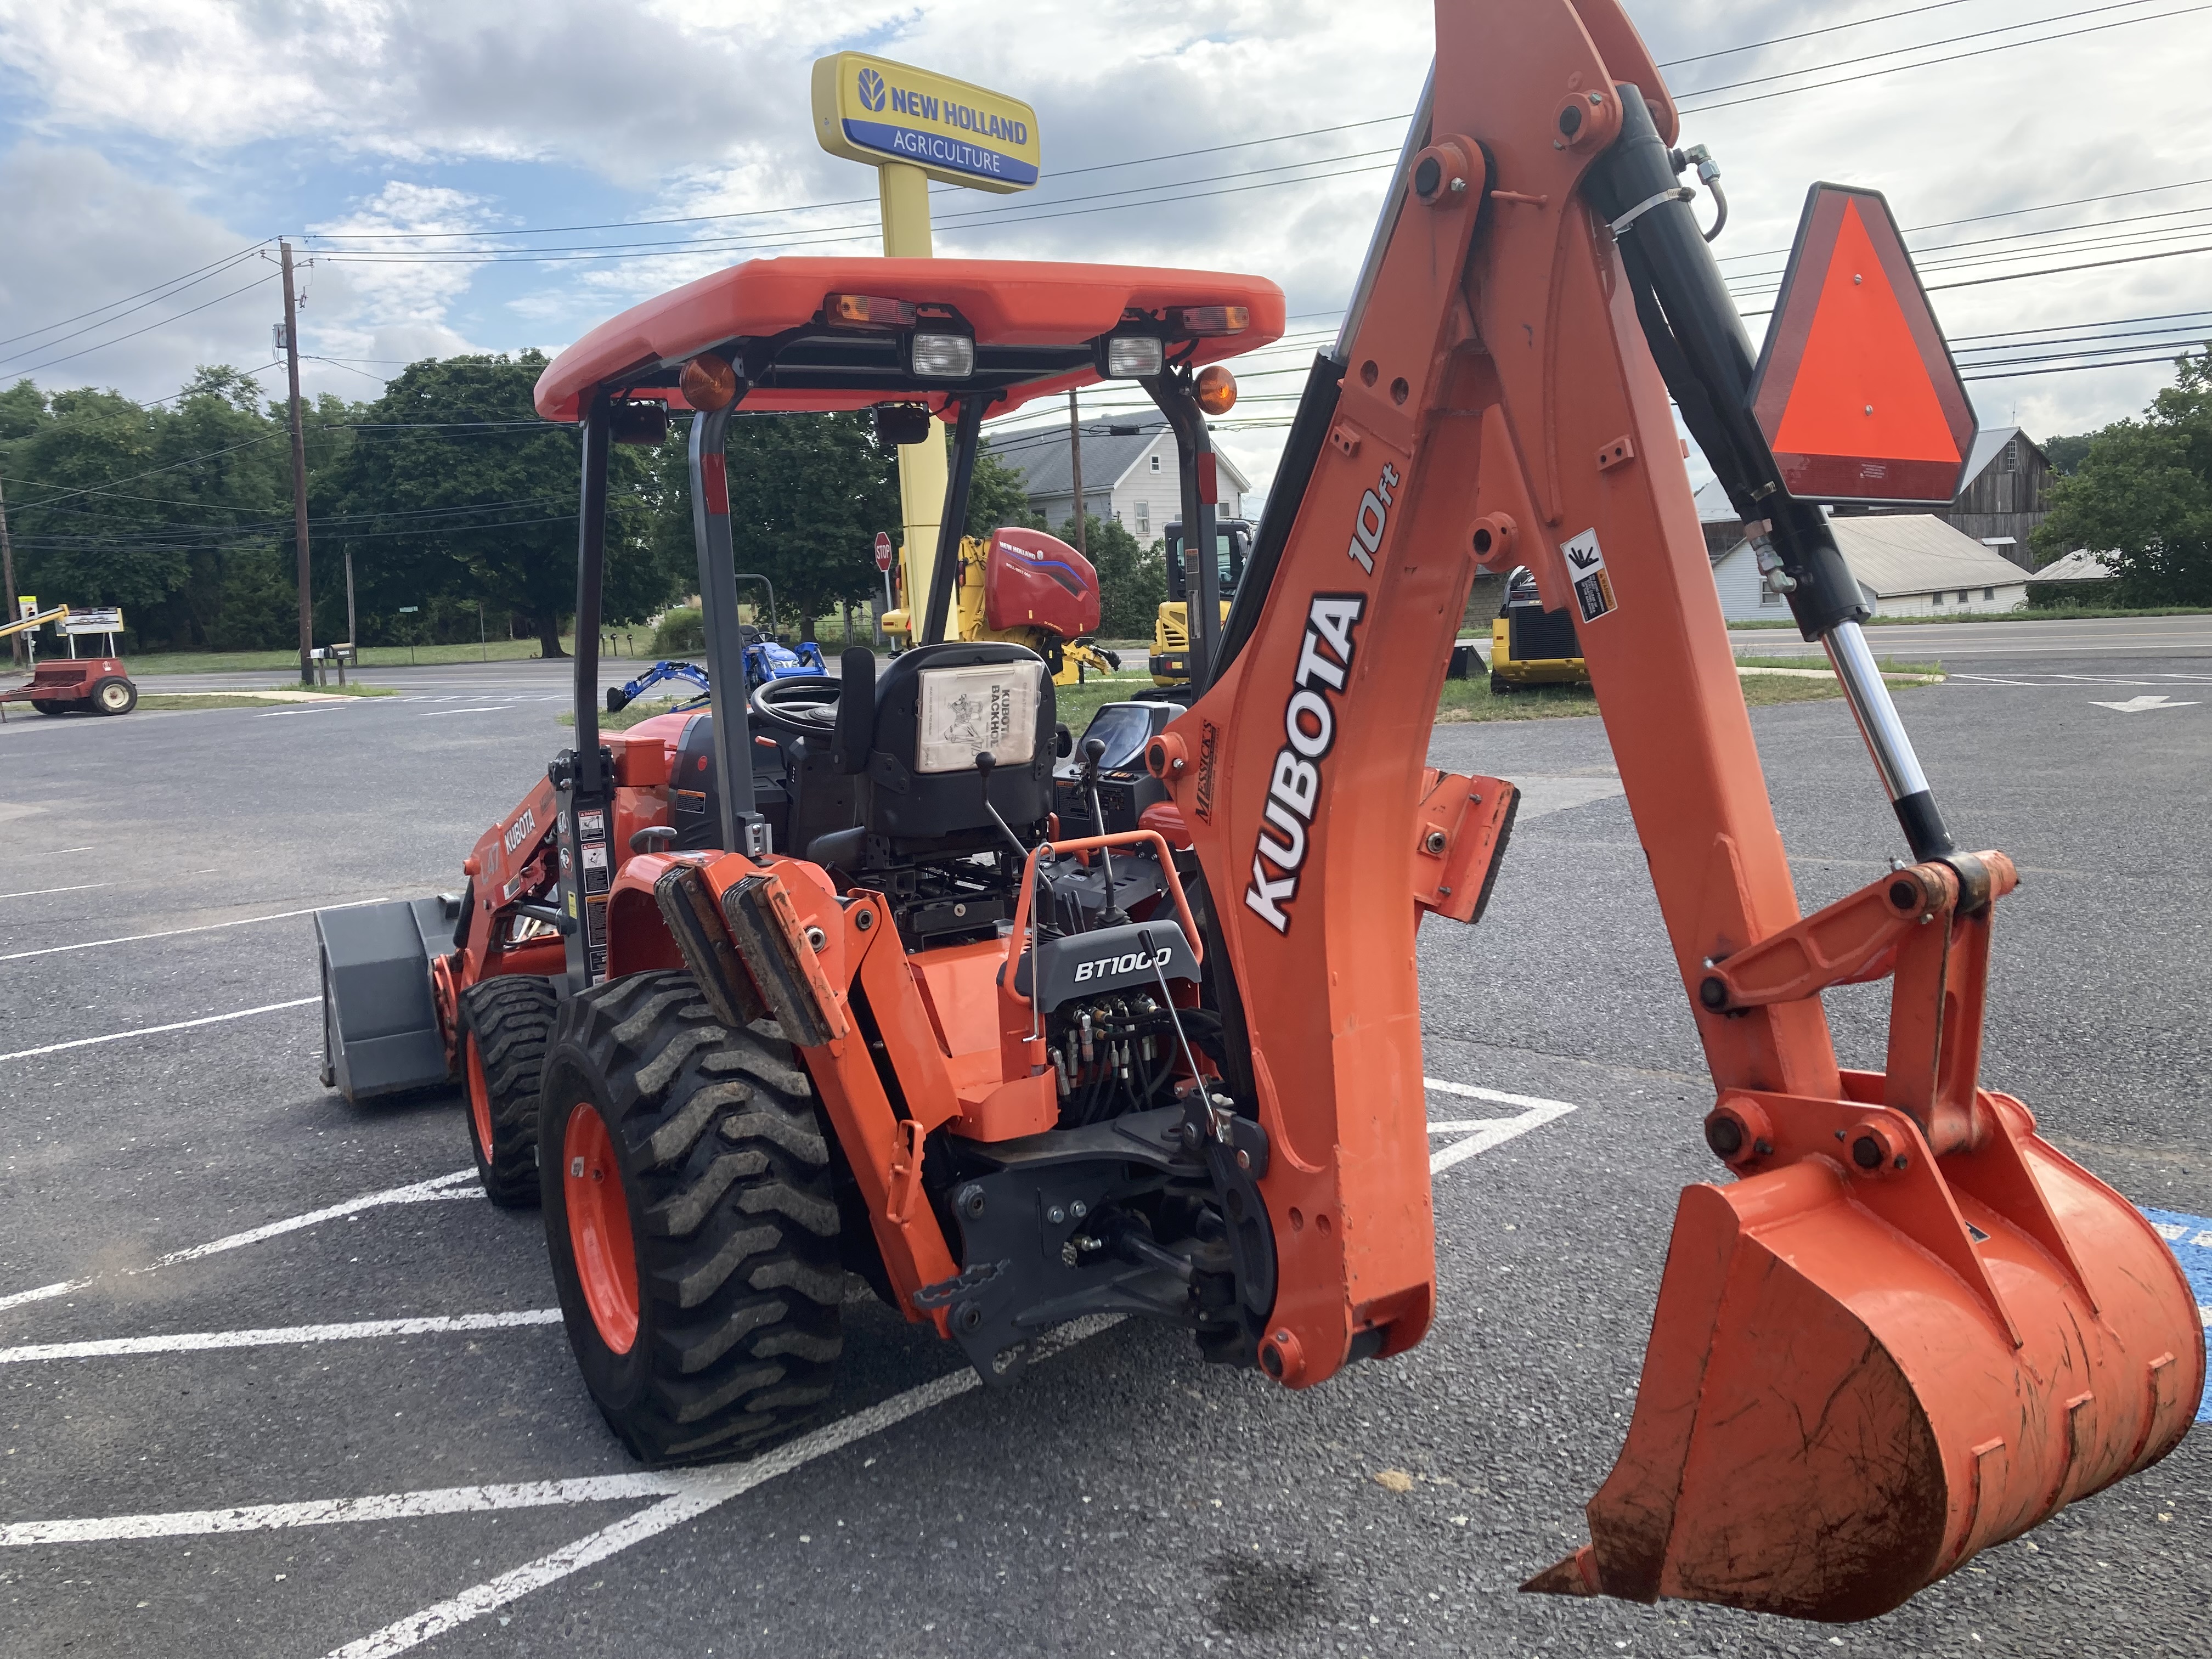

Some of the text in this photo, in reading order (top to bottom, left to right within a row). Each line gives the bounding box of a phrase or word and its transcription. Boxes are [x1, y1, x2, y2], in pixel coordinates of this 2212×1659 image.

[890, 86, 1027, 145] NEW HOLLAND
[894, 129, 1001, 173] AGRICULTURE
[876, 544, 890, 560] STOP
[999, 541, 1036, 560] NEW HOLLAND
[1601, 578, 1613, 607] WARNING
[990, 685, 1000, 748] BACKHOE
[1195, 719, 1212, 825] MESSICK'S
[1245, 597, 1363, 933] KUBOTA
[504, 808, 536, 856] KUBOTA
[1074, 947, 1172, 983] BT1000
